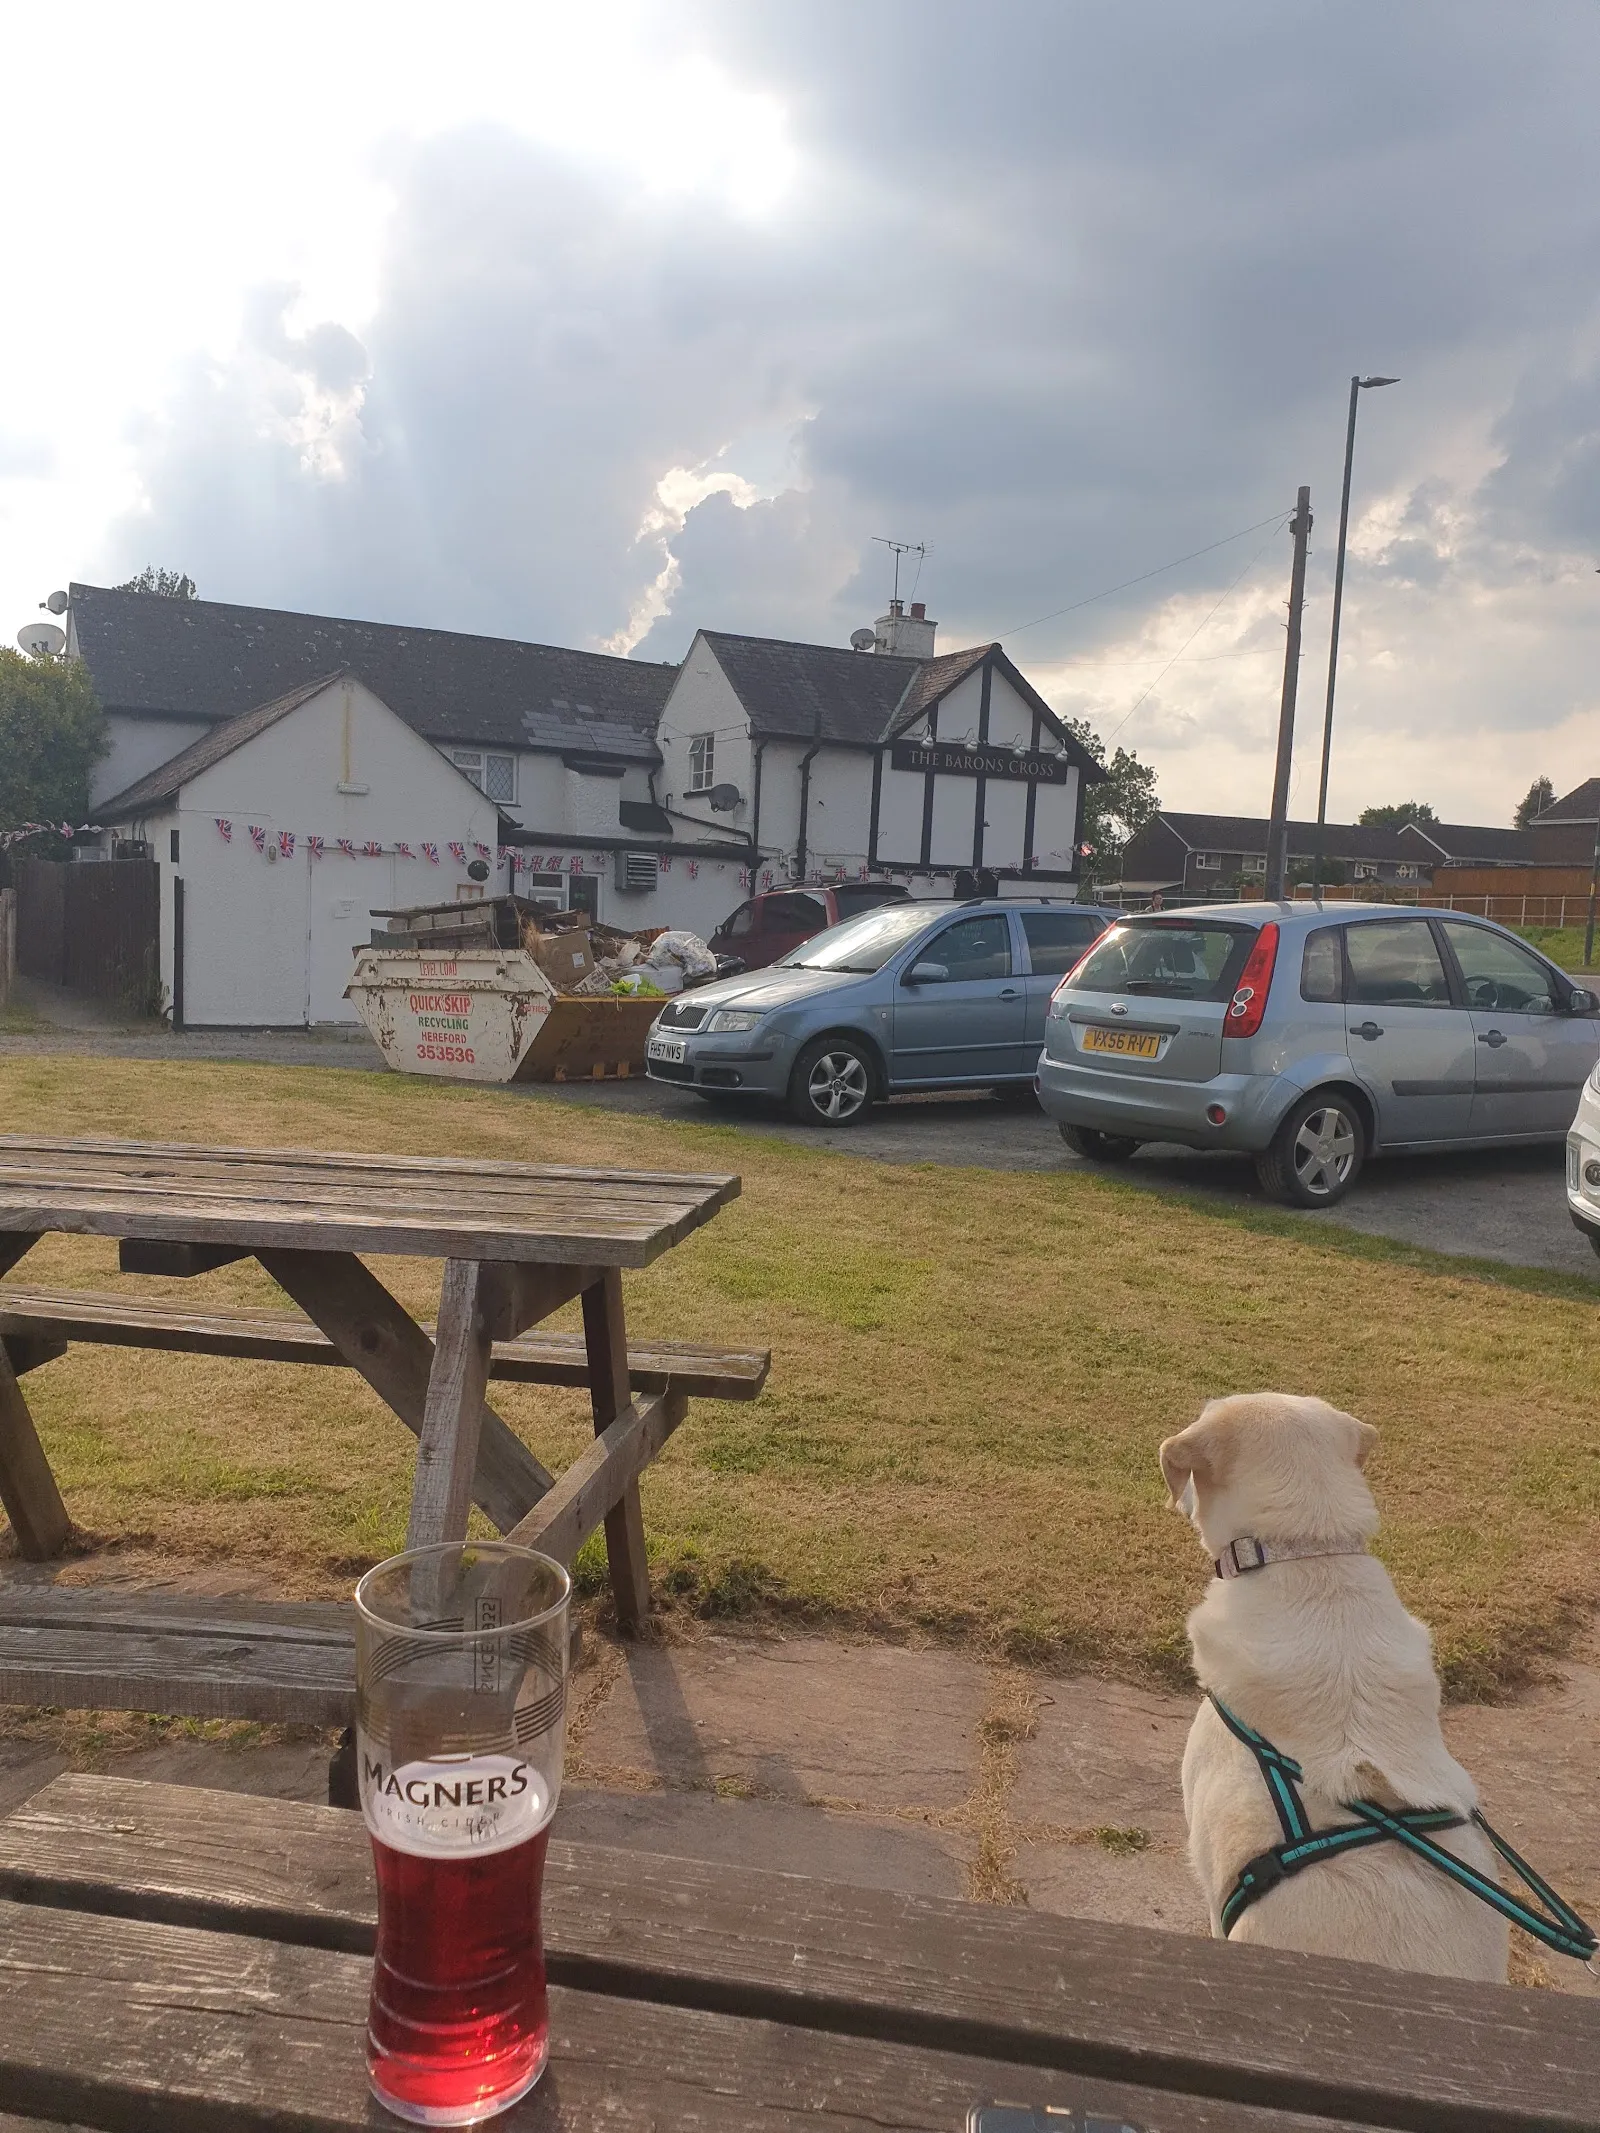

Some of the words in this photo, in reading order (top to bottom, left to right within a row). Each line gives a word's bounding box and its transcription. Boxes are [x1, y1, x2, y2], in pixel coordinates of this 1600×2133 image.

[909, 750, 940, 766] THE
[945, 754, 1004, 772] BARONS
[1008, 760, 1054, 777] CROSS
[419, 961, 439, 977] LEVEL
[440, 961, 458, 977] LOAD
[410, 994, 442, 1015] QUICK
[444, 995, 471, 1013] SKIP
[418, 1016, 469, 1030] RECYCLING
[421, 1031, 467, 1044] HEREFORD
[1093, 1030, 1125, 1049] VX56
[1127, 1034, 1156, 1053] RVT
[416, 1044, 475, 1064] 353536
[364, 1753, 529, 1808] MAGNERS
[380, 1805, 425, 1826] IRISH
